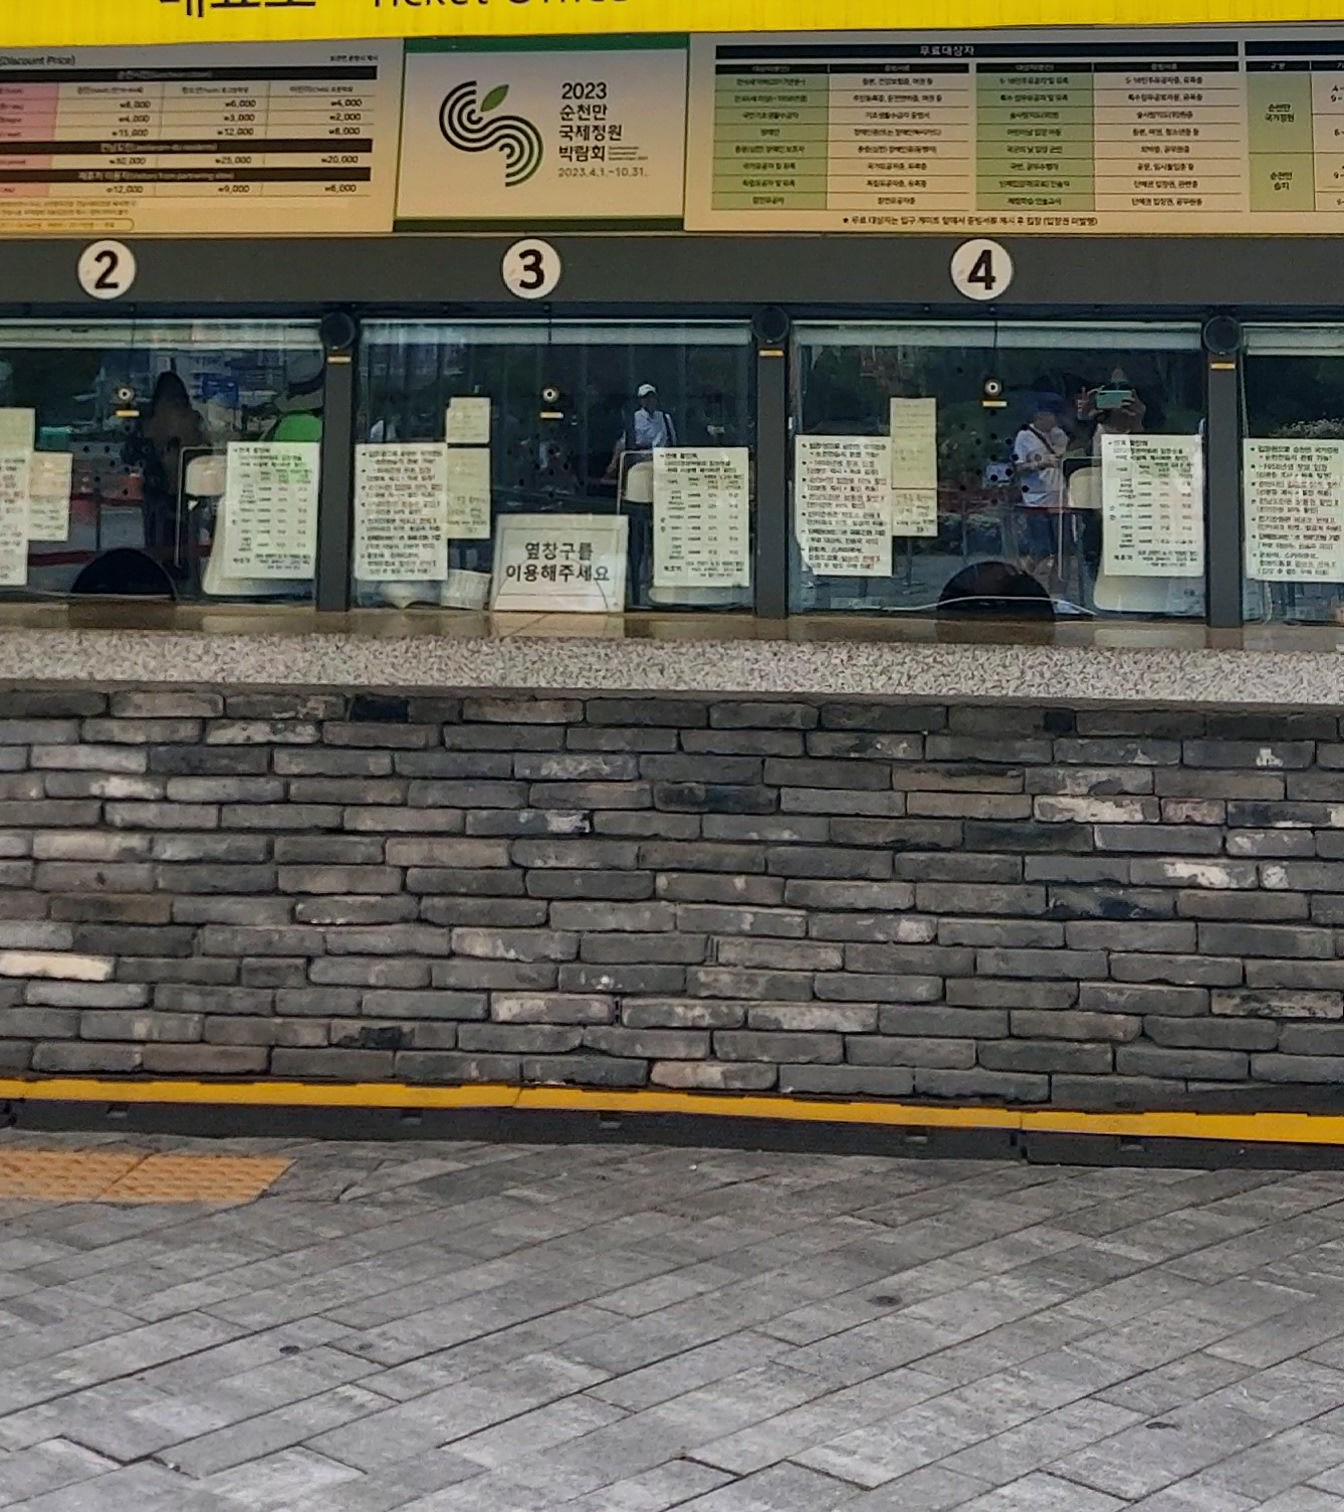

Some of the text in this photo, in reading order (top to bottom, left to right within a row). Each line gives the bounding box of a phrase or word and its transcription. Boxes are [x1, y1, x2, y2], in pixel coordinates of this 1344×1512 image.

[561, 82, 607, 100] 2023
[559, 103, 607, 122] 순천만
[559, 124, 623, 141] 국제정원
[558, 144, 605, 162] 박람회
[94, 249, 120, 290] 2
[518, 248, 545, 289] 3
[966, 248, 996, 291] 4
[524, 541, 594, 560] 옆창구를
[505, 563, 611, 584] 이용해주세요
